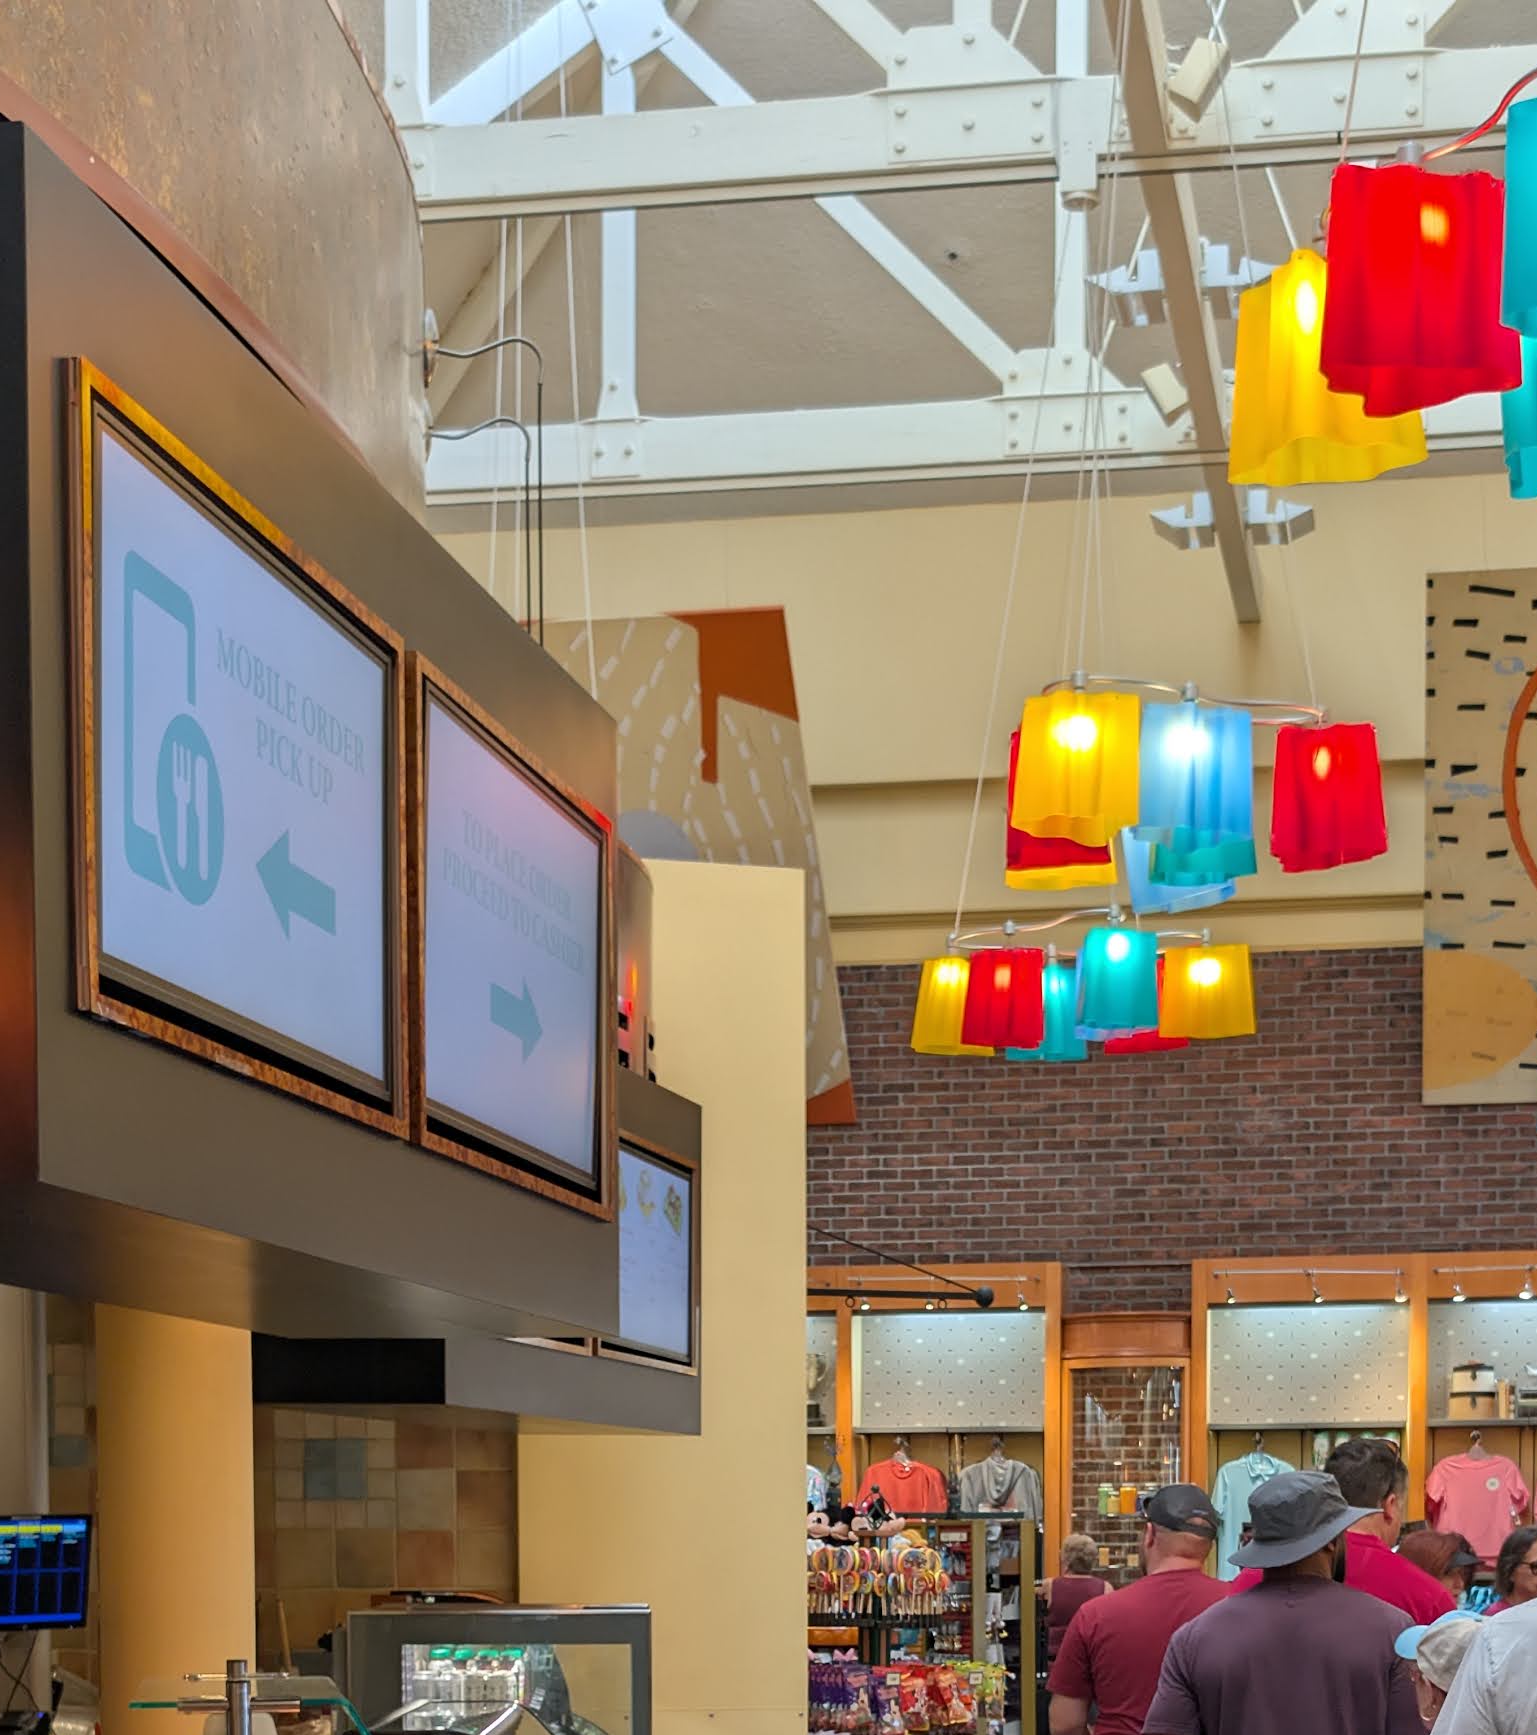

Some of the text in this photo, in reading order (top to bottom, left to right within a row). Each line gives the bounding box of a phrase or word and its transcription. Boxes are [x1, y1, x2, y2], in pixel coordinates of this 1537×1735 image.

[217, 627, 365, 777] MOBILE ORDER
[256, 717, 333, 806] PICK UP
